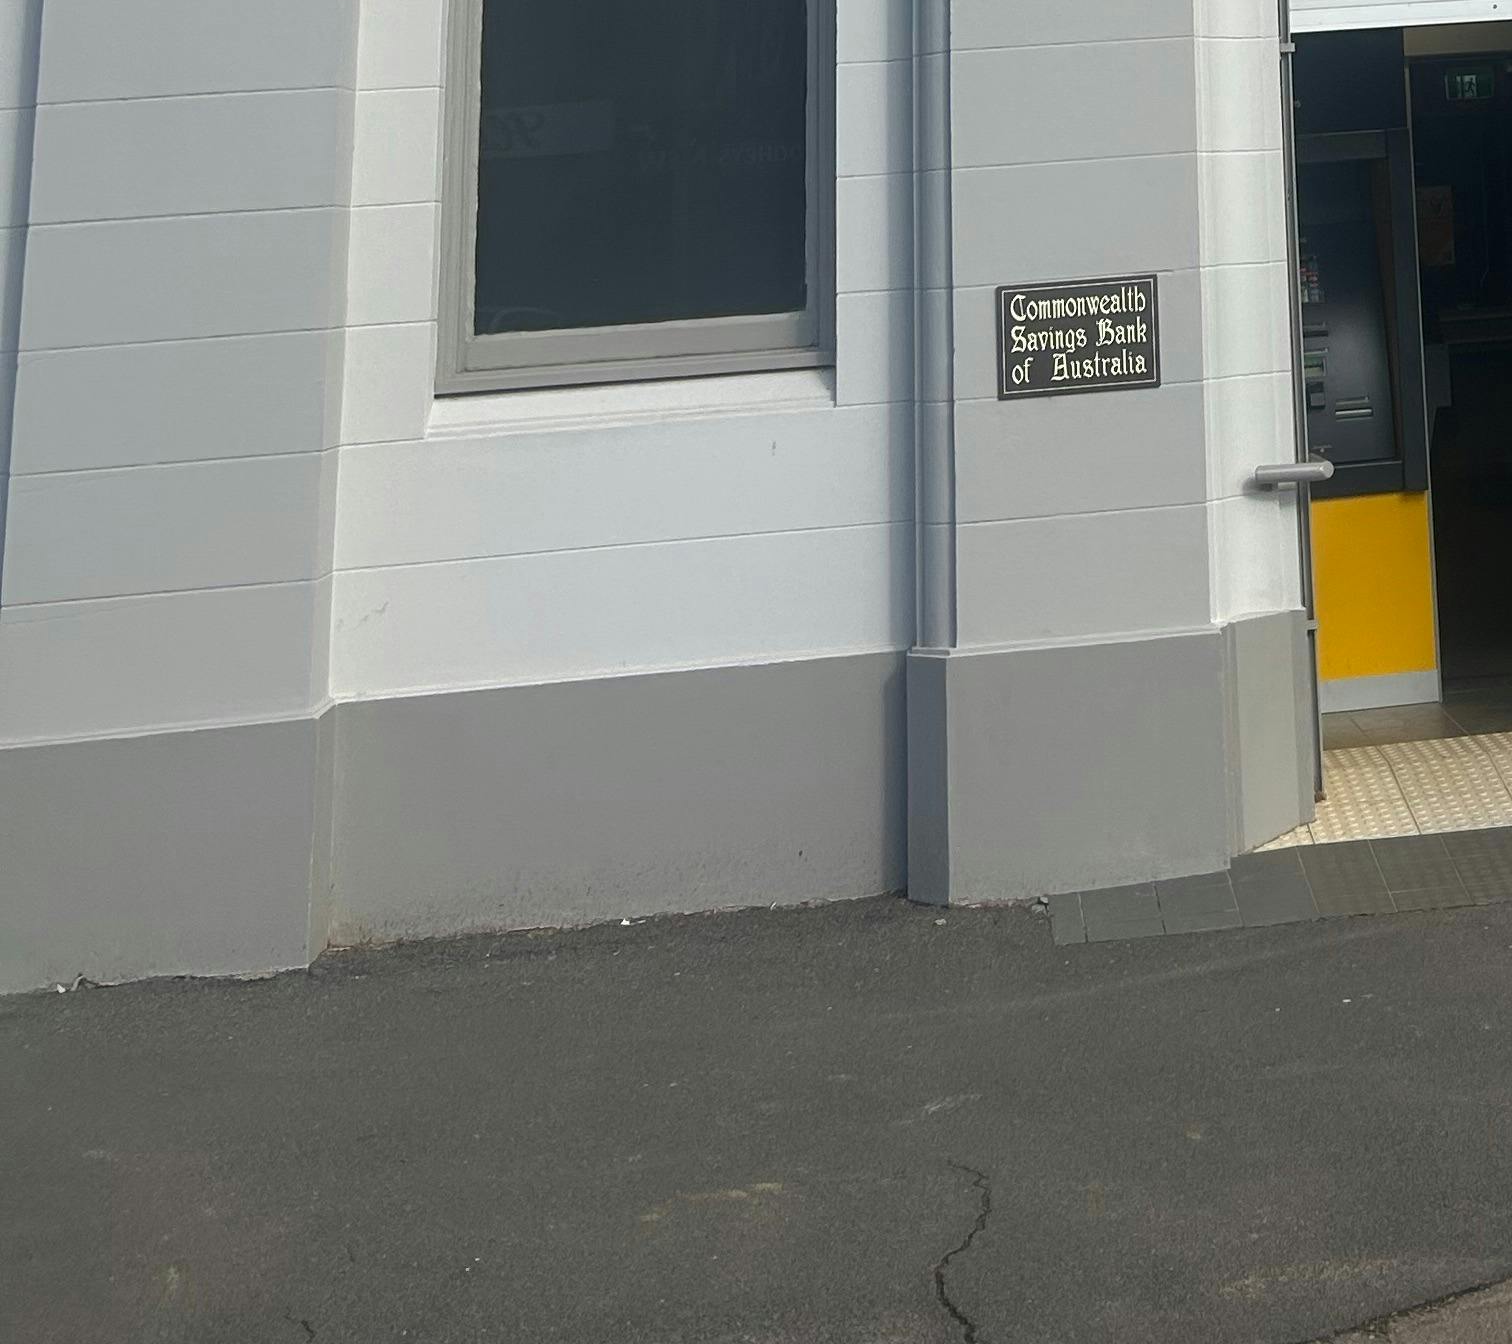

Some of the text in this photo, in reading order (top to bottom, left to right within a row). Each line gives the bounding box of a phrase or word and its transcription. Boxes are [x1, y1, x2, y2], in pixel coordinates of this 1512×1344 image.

[1010, 285, 1146, 321] Commonwealth
[1011, 316, 1147, 353] Savings Bank
[1011, 349, 1147, 384] of Australia
